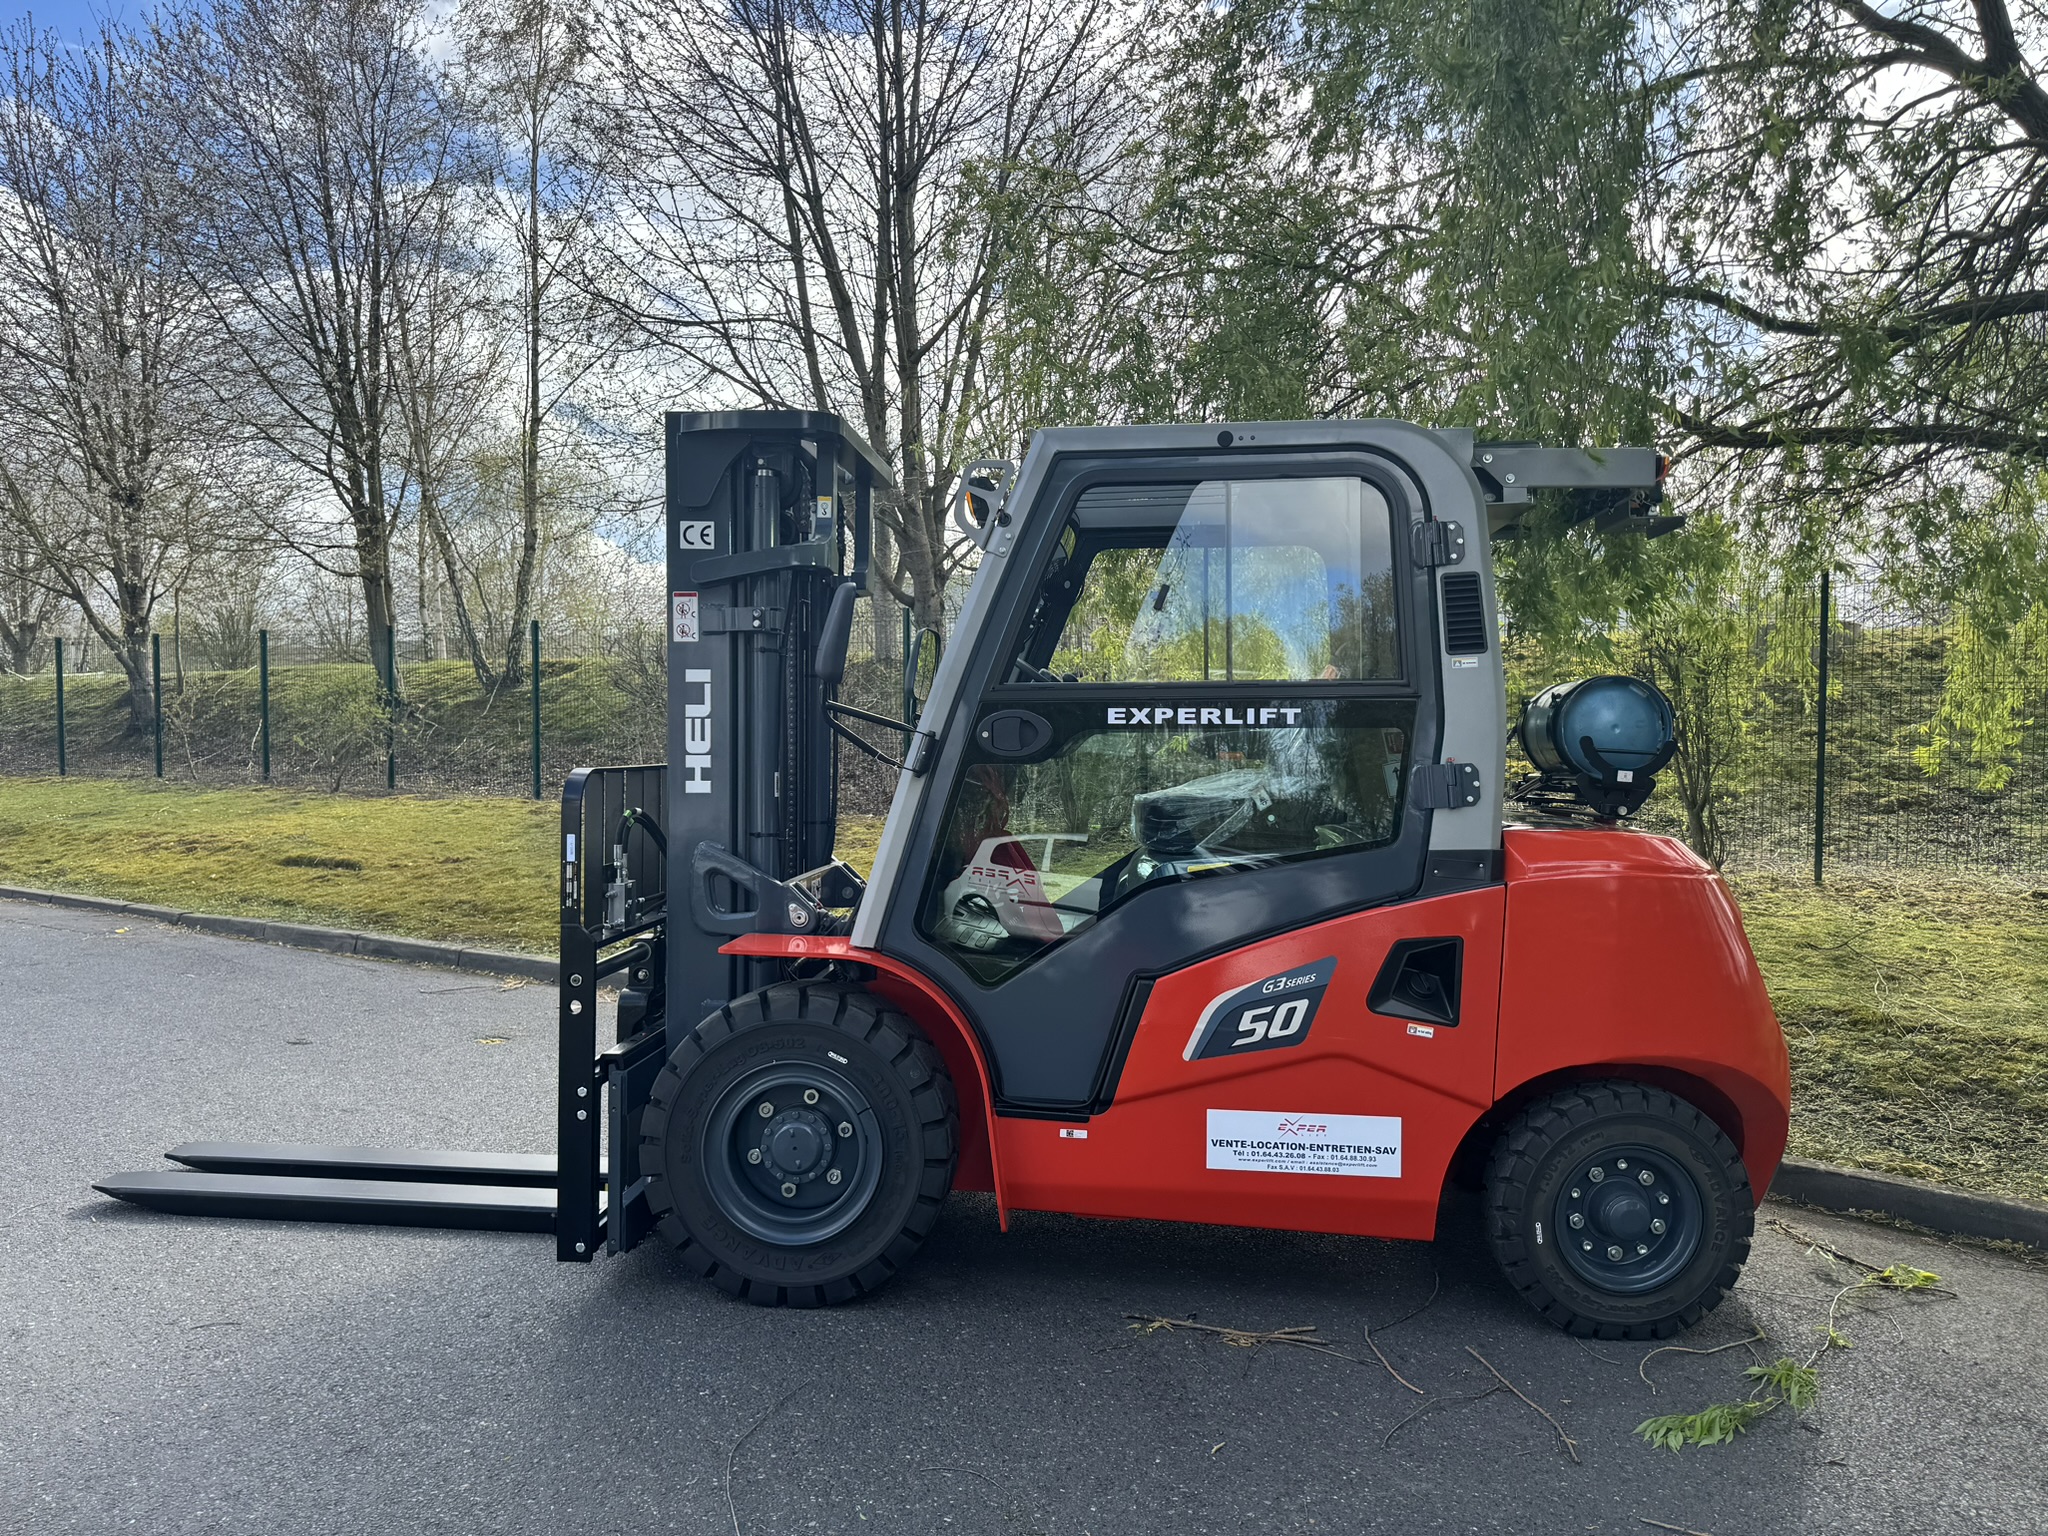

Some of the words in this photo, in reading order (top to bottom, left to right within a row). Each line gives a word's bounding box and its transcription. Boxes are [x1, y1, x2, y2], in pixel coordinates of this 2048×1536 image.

[683, 524, 712, 546] CE
[1107, 706, 1302, 726] EXPERLIFT
[685, 668, 712, 794] HELI
[1262, 976, 1287, 994] G3
[1285, 973, 1317, 988] SERIES
[1231, 998, 1310, 1047] 50
[1210, 1138, 1397, 1155] VENTE-LOCATION-ENTRETIEN-SAV
[1251, 1150, 1306, 1160] 01.64.43.26.08
[699, 1214, 804, 1272] ADVANCE
